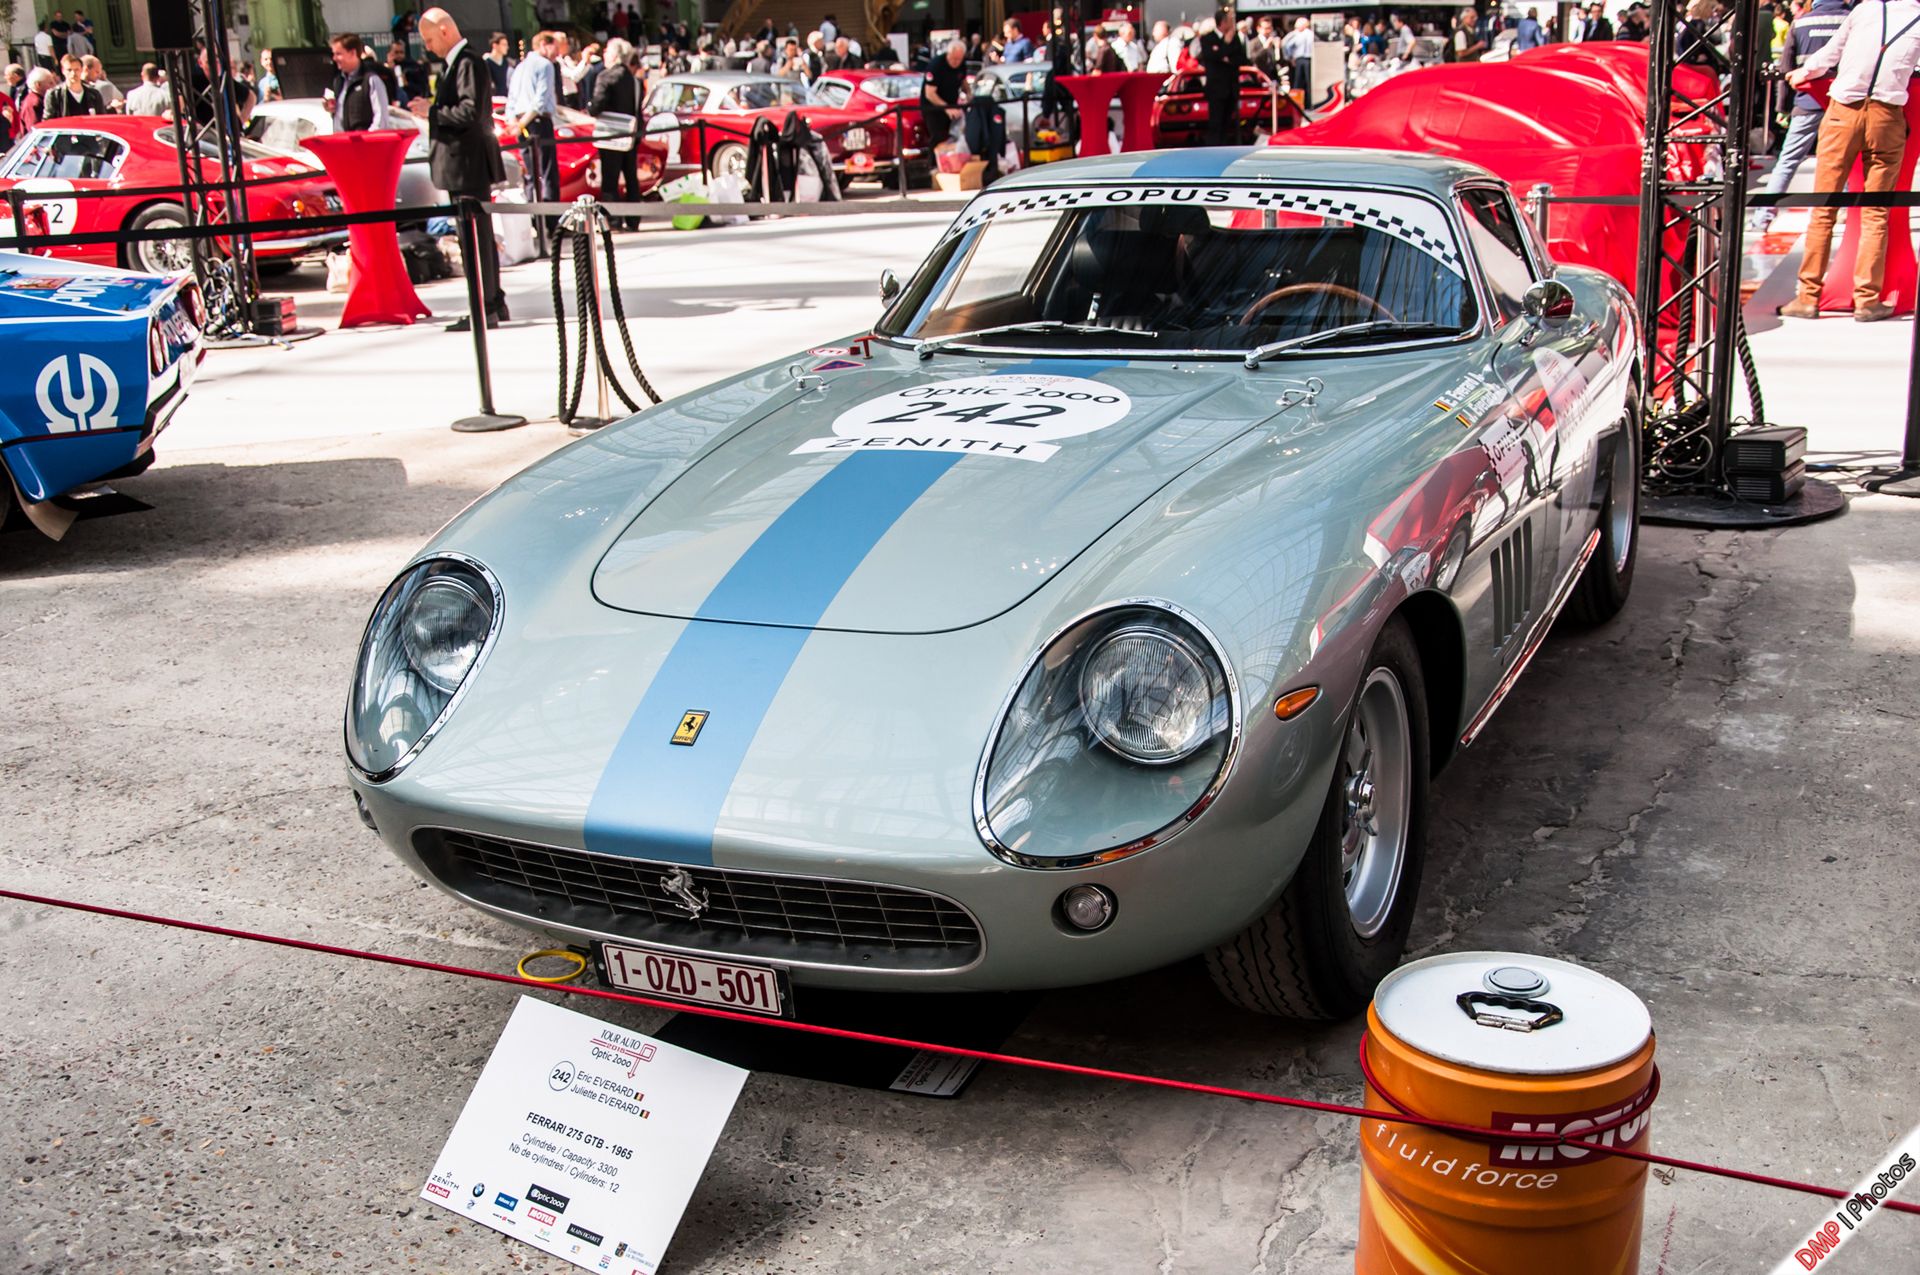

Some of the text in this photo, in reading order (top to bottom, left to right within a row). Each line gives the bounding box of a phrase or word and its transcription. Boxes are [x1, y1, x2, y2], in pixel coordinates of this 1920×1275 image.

[1106, 189, 1231, 203] OPUS
[899, 385, 1120, 404] Optic 2000
[867, 401, 1066, 428] 242
[826, 437, 1028, 454] ZENITH
[1492, 430, 1519, 462] OPUS
[601, 1029, 641, 1050] TOUR AUTO
[591, 1047, 632, 1068] Optic 2000
[552, 1069, 571, 1084] 242
[577, 1070, 634, 1097] Eric EVERARD
[570, 1084, 640, 1115] Juliette EVERARD
[526, 1112, 567, 1134] FERRARI
[567, 1128, 584, 1141] 275
[584, 1134, 605, 1149] GTB
[612, 1143, 633, 1160] 1965
[522, 1133, 557, 1154] Cylindrée
[562, 1148, 596, 1173] Capacity:
[597, 1163, 618, 1177] 3300
[1376, 1123, 1558, 1189] fluid force
[509, 1143, 520, 1154] Nb
[521, 1147, 531, 1158] de
[531, 1152, 563, 1171] cylindres
[569, 1167, 607, 1188] Cylinders:
[609, 1182, 620, 1193] 12
[432, 1174, 460, 1191] ZENITH
[530, 1209, 555, 1224] MOTUL
